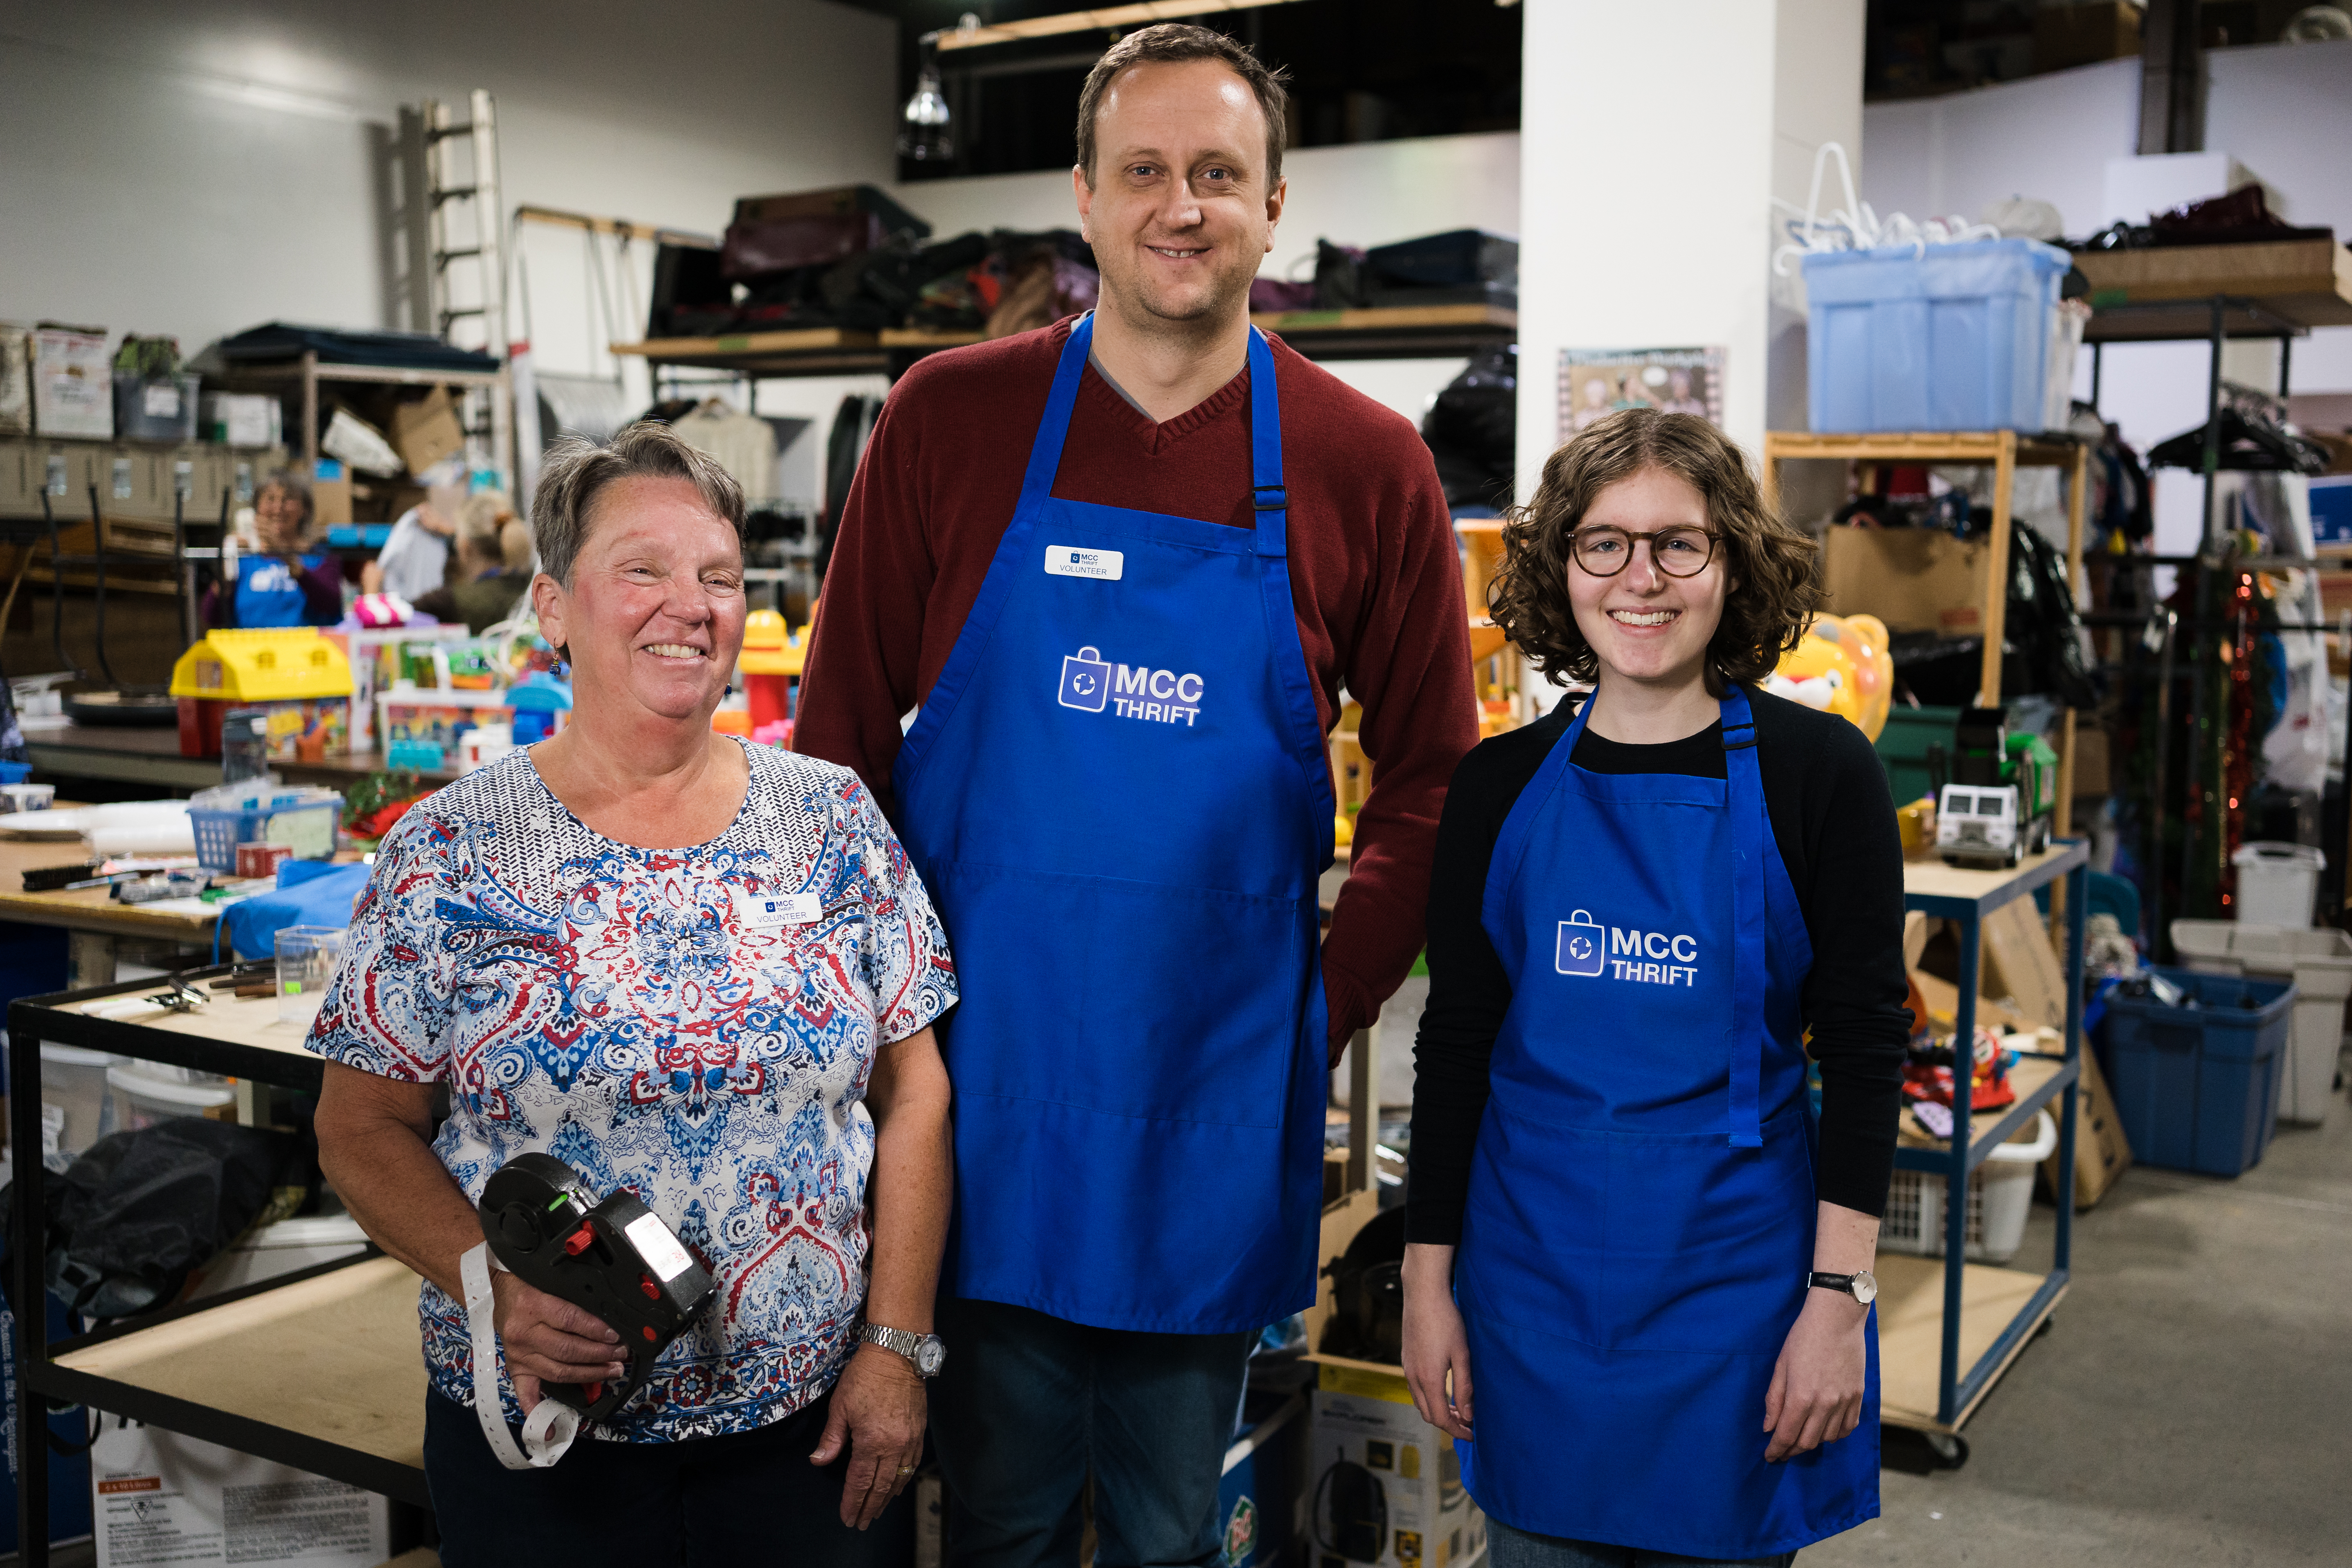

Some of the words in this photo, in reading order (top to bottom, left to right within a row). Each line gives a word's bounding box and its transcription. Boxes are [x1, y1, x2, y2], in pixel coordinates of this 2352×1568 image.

[1060, 564, 1107, 576] VOLUNTEER
[1115, 664, 1204, 703] MCC
[1114, 698, 1200, 727] THRIFT
[756, 912, 807, 923] VOLUNTEER
[1611, 927, 1697, 962] MCC
[1611, 960, 1698, 987] THRIFT
